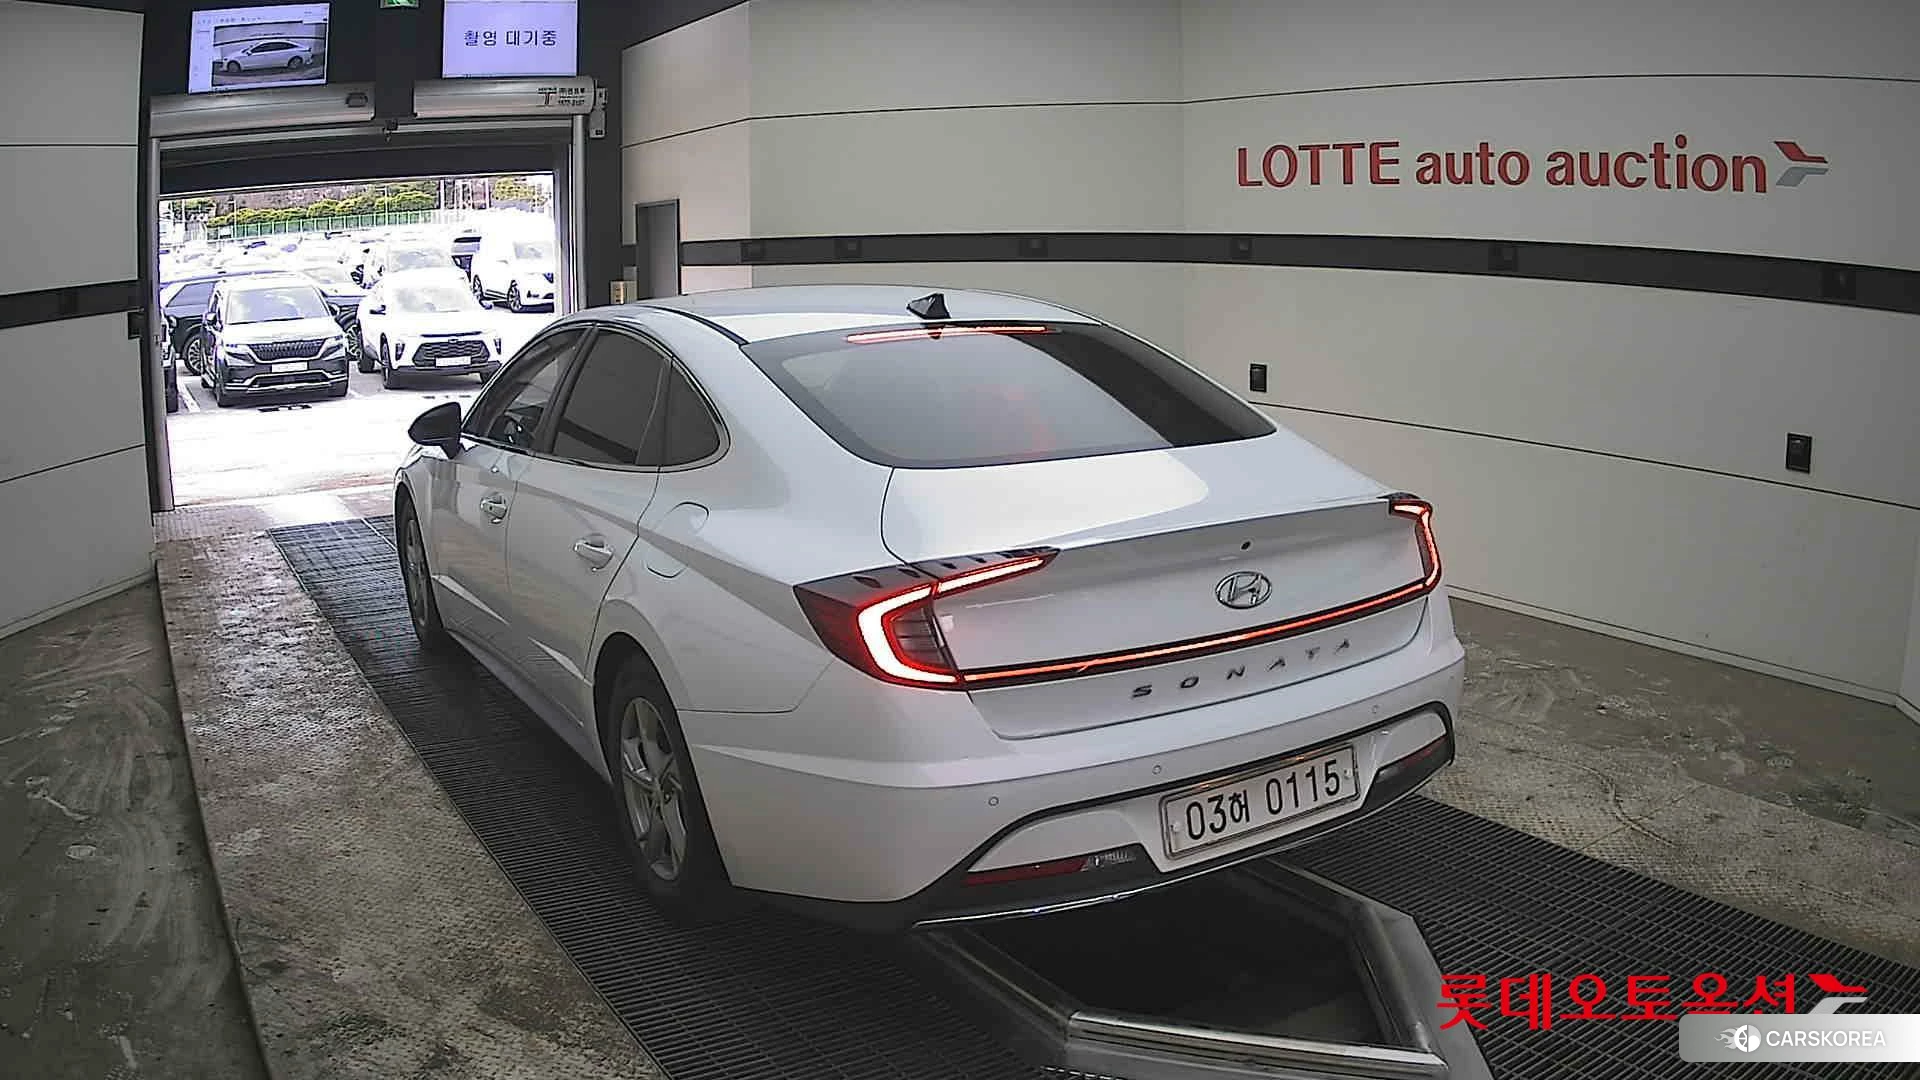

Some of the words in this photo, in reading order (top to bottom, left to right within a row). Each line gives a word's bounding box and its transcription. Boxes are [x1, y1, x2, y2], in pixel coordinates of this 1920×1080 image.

[464, 30, 497, 47] 촬영
[505, 30, 557, 46] 대기중
[1236, 141, 1399, 187] LOTTE
[1416, 141, 1531, 185] auto
[1546, 134, 1767, 193] auction
[1131, 638, 1350, 699] SONATA
[1186, 789, 1250, 840] 03허
[1265, 759, 1341, 815] 0115
